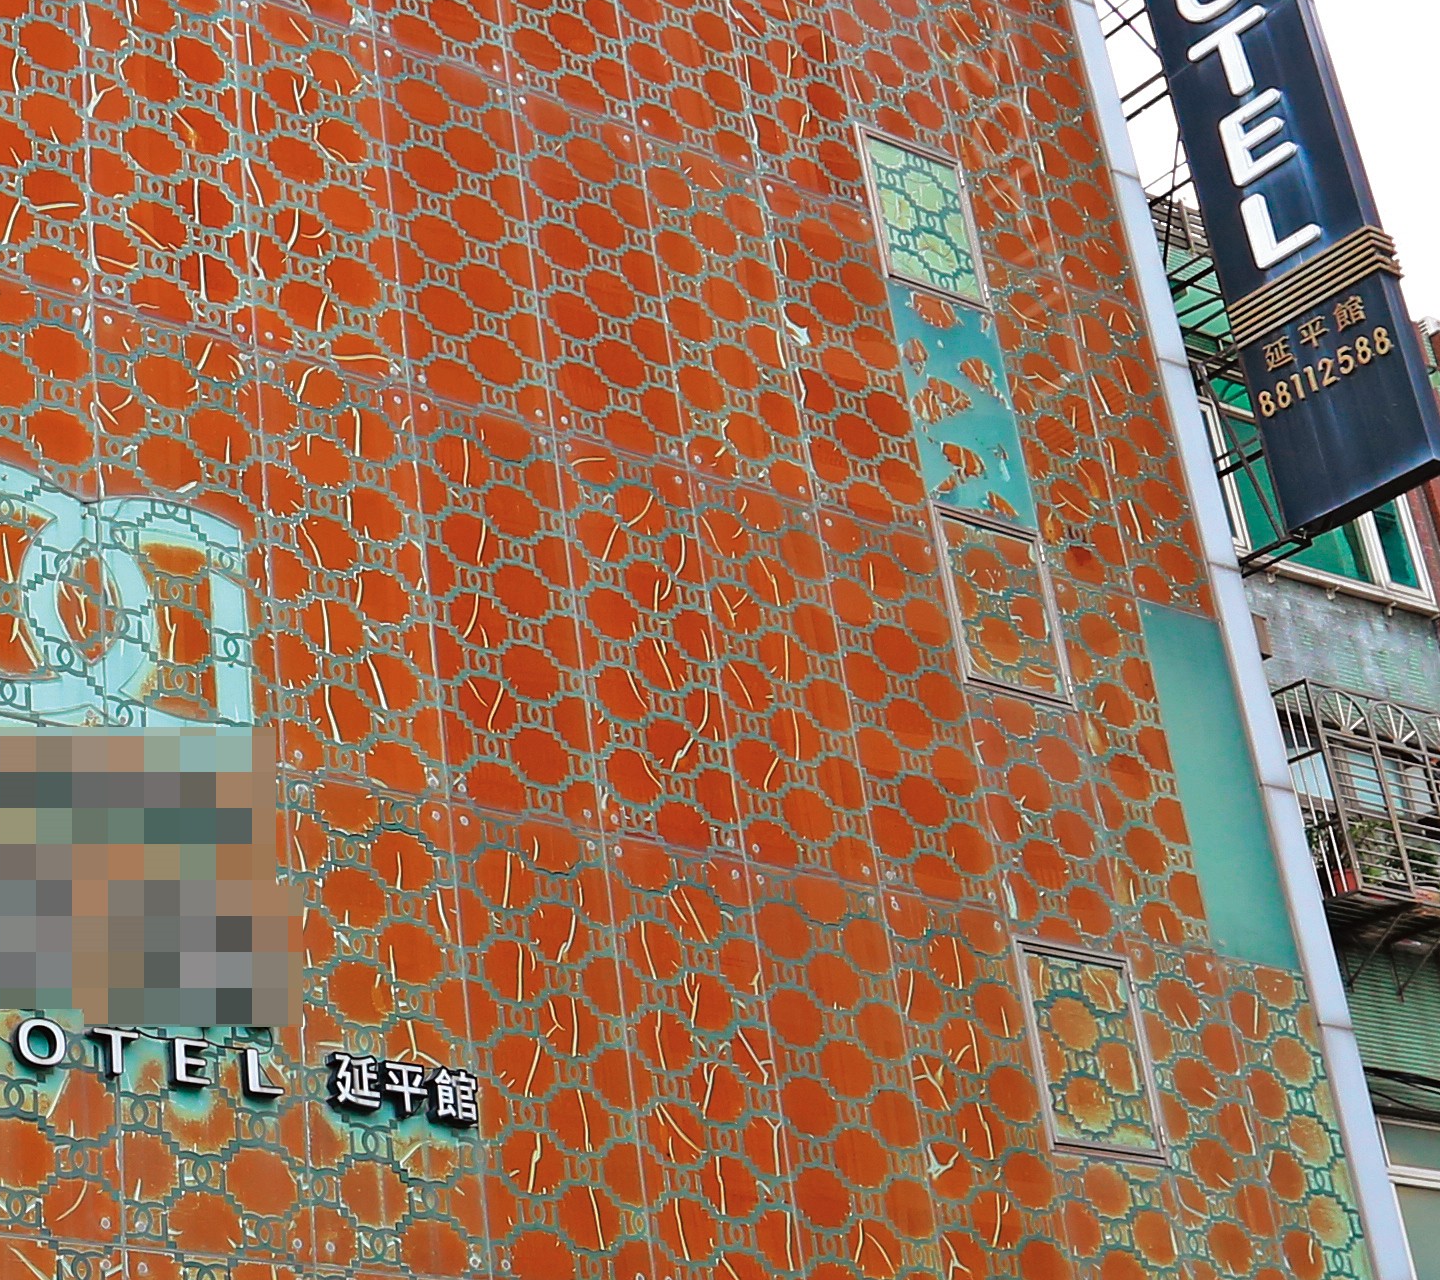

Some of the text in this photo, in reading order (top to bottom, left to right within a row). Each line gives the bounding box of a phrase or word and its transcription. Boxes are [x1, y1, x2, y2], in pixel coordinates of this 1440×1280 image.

[1261, 295, 1367, 372] 延平館
[1258, 327, 1393, 418] 88112588
[330, 1052, 478, 1125] 延平館
